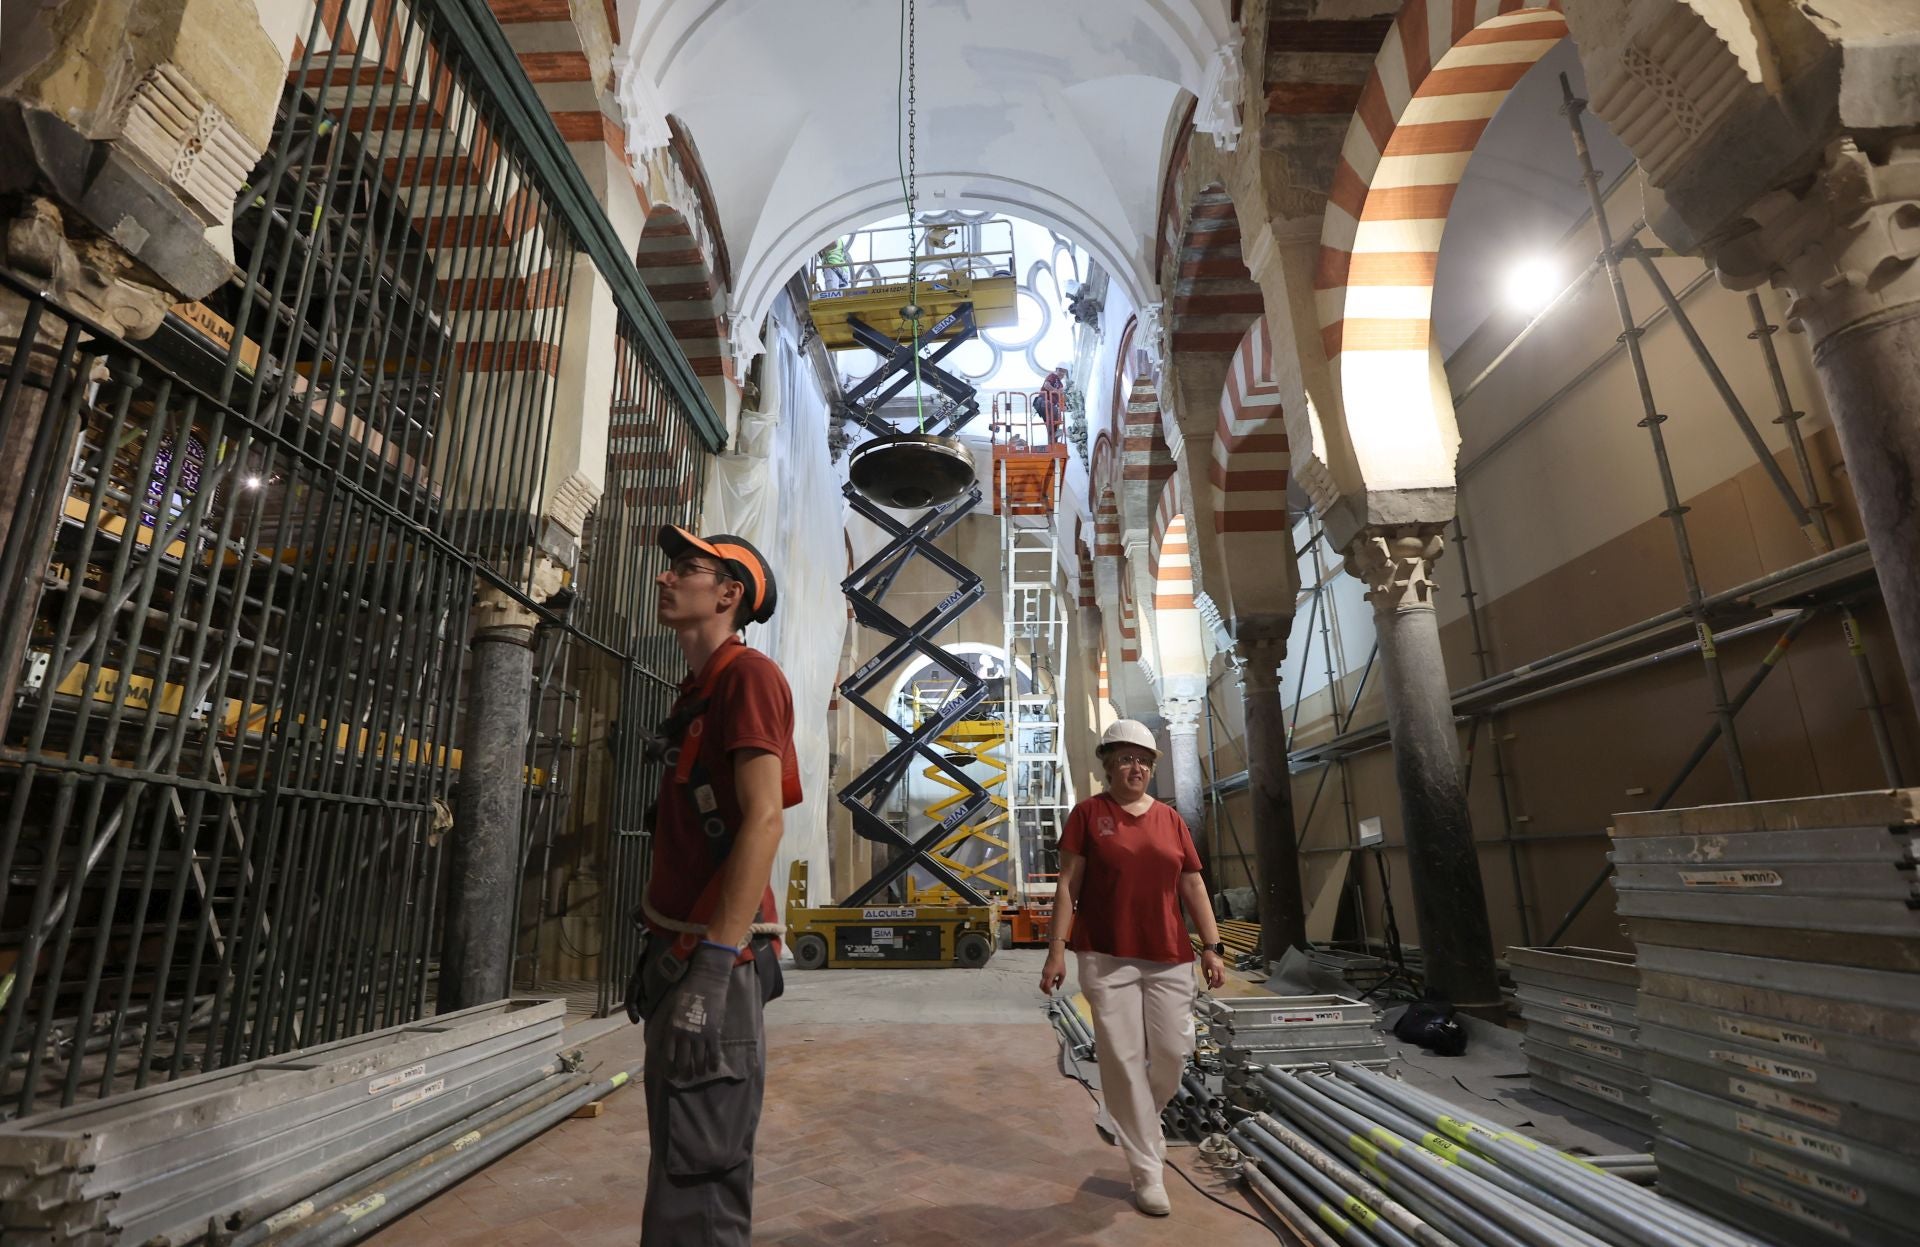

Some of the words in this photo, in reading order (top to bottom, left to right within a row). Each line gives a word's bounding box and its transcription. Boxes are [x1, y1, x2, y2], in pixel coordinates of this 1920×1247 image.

[820, 291, 841, 299] SIM
[201, 313, 233, 344] ULM
[934, 316, 956, 334] SIM
[939, 591, 962, 611] SIM
[104, 680, 150, 701] UMA
[941, 696, 965, 717] SIM
[943, 807, 967, 828] SIM
[865, 910, 915, 918] ALQUILER
[1774, 1065, 1801, 1079] ULMA
